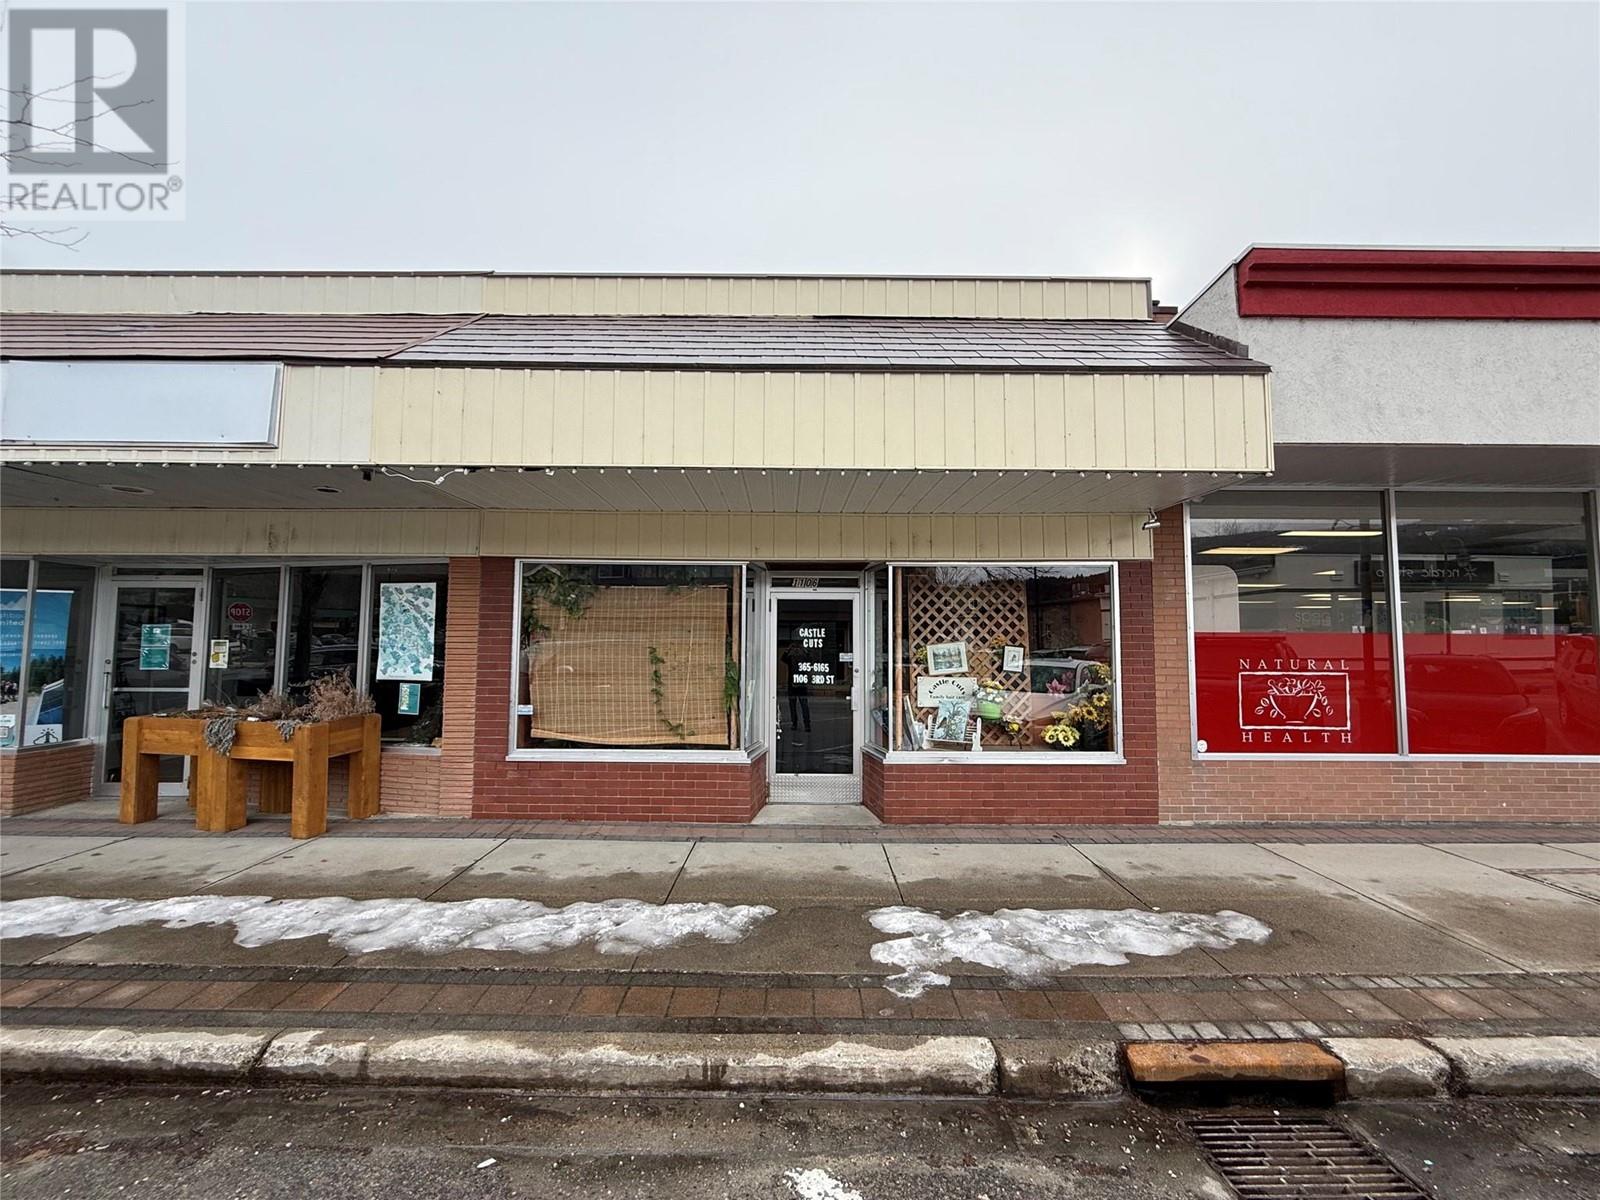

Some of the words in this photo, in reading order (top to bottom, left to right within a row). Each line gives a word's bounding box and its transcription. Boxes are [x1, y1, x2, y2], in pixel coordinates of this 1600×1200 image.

[792, 577, 819, 588] 1106
[799, 628, 826, 637] CASTLE
[803, 639, 823, 648] CUTS
[798, 662, 830, 672] 365-6165
[1239, 659, 1349, 670] NATURAL
[793, 674, 808, 683] 1106
[811, 675, 825, 684] 3RD
[826, 675, 835, 684] ST
[928, 679, 950, 694] Castle
[951, 680, 966, 695] Cuts
[1241, 732, 1352, 743] HEALTH
